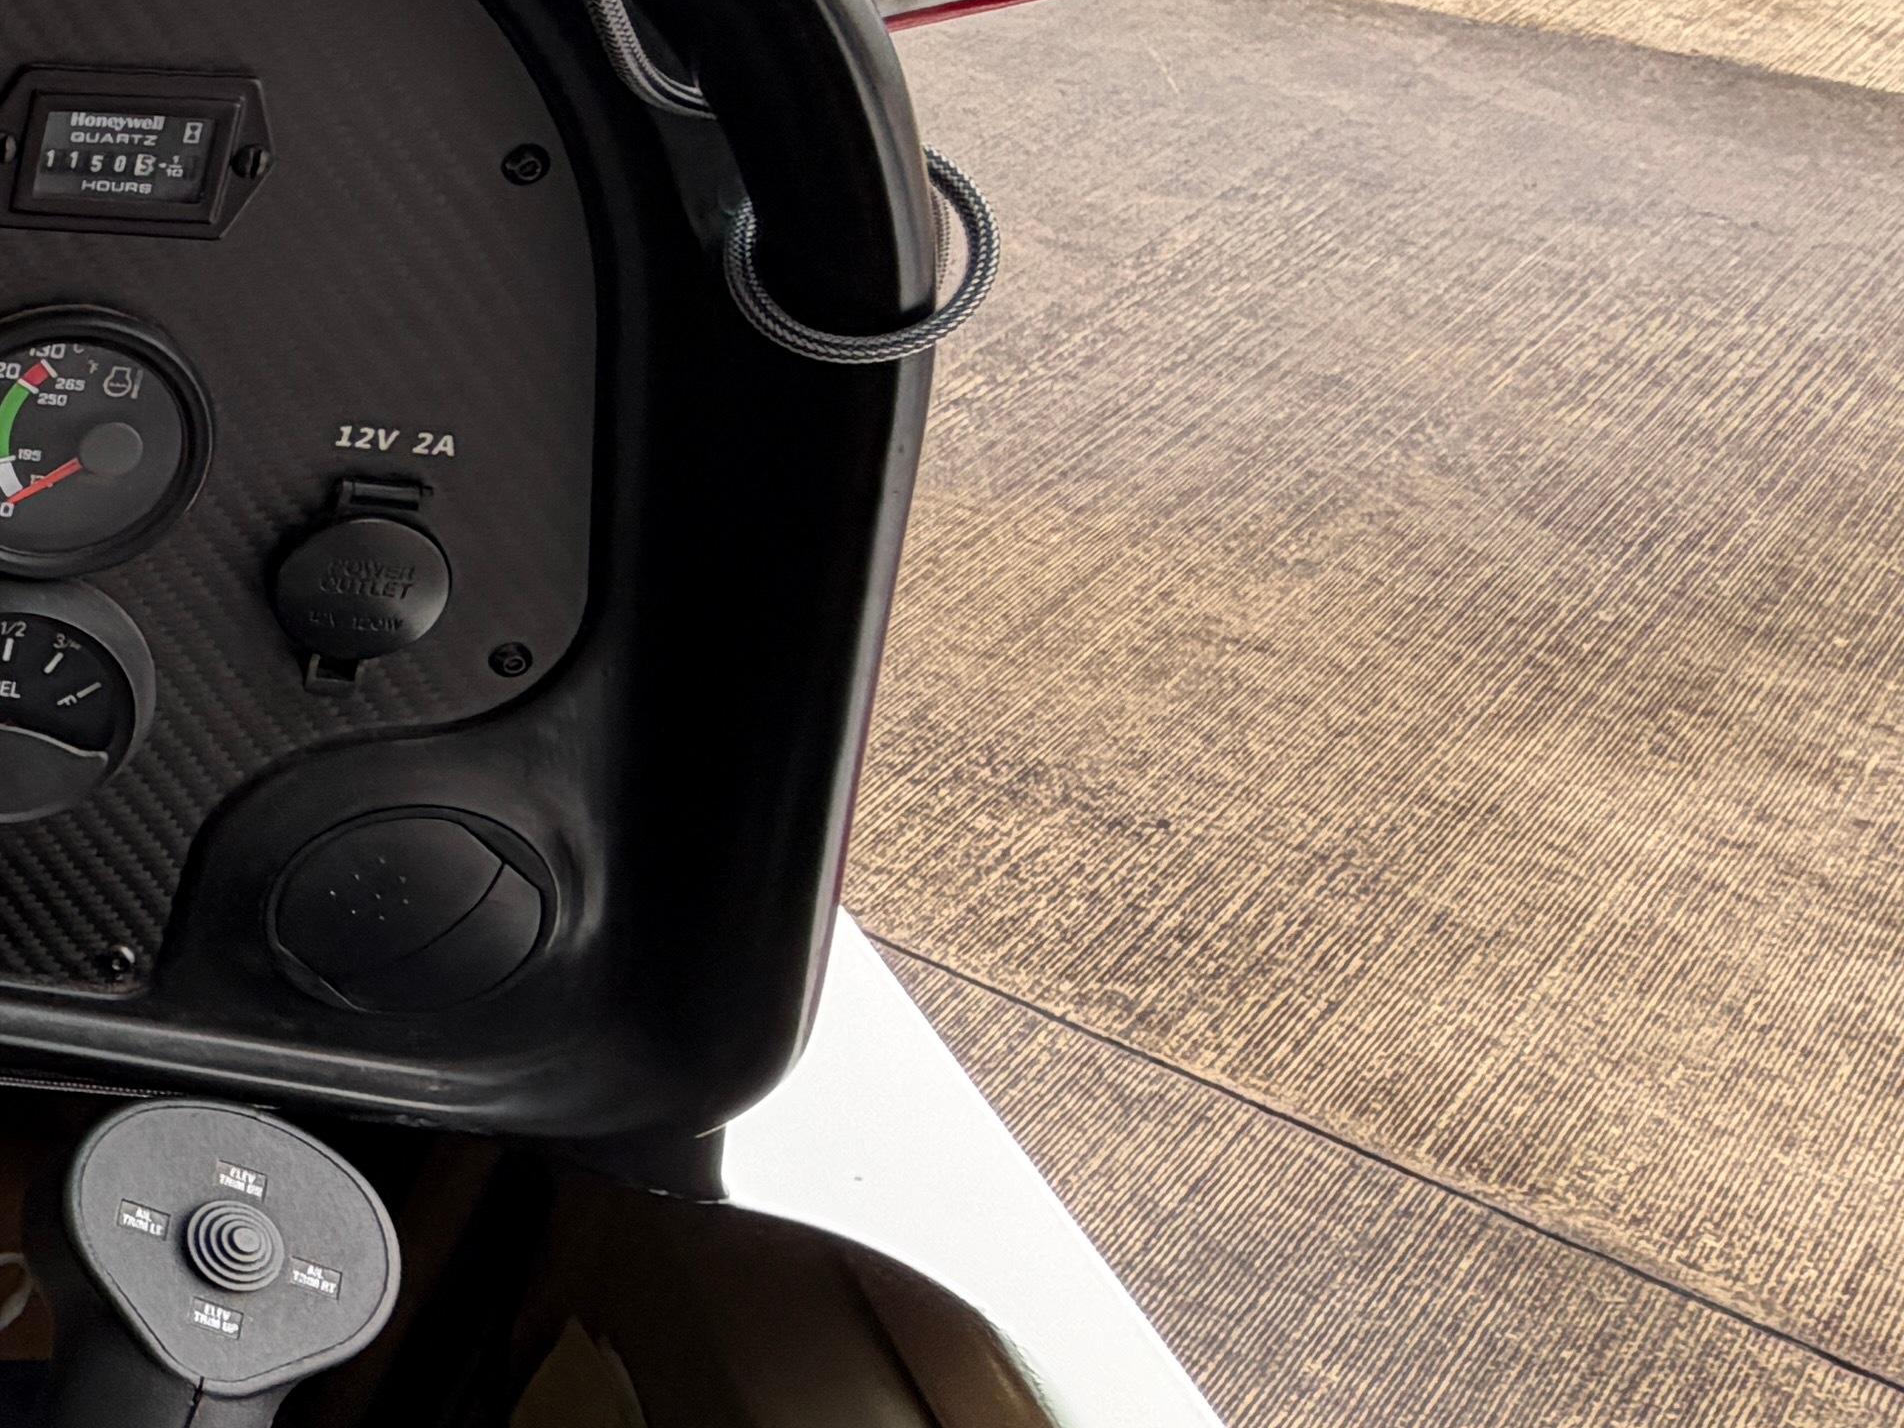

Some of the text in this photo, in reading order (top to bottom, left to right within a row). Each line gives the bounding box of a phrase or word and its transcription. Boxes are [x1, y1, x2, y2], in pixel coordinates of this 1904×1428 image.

[70, 112, 166, 131] Honeywell
[70, 131, 158, 146] QUARTZ
[81, 179, 153, 194] HOURS
[55, 378, 86, 392] 265
[37, 393, 68, 408] 250
[335, 425, 456, 457] 12V 2A
[328, 558, 416, 580] POWER
[320, 577, 413, 600] OUTLET
[0, 621, 27, 638] 1/2
[56, 694, 78, 707] F
